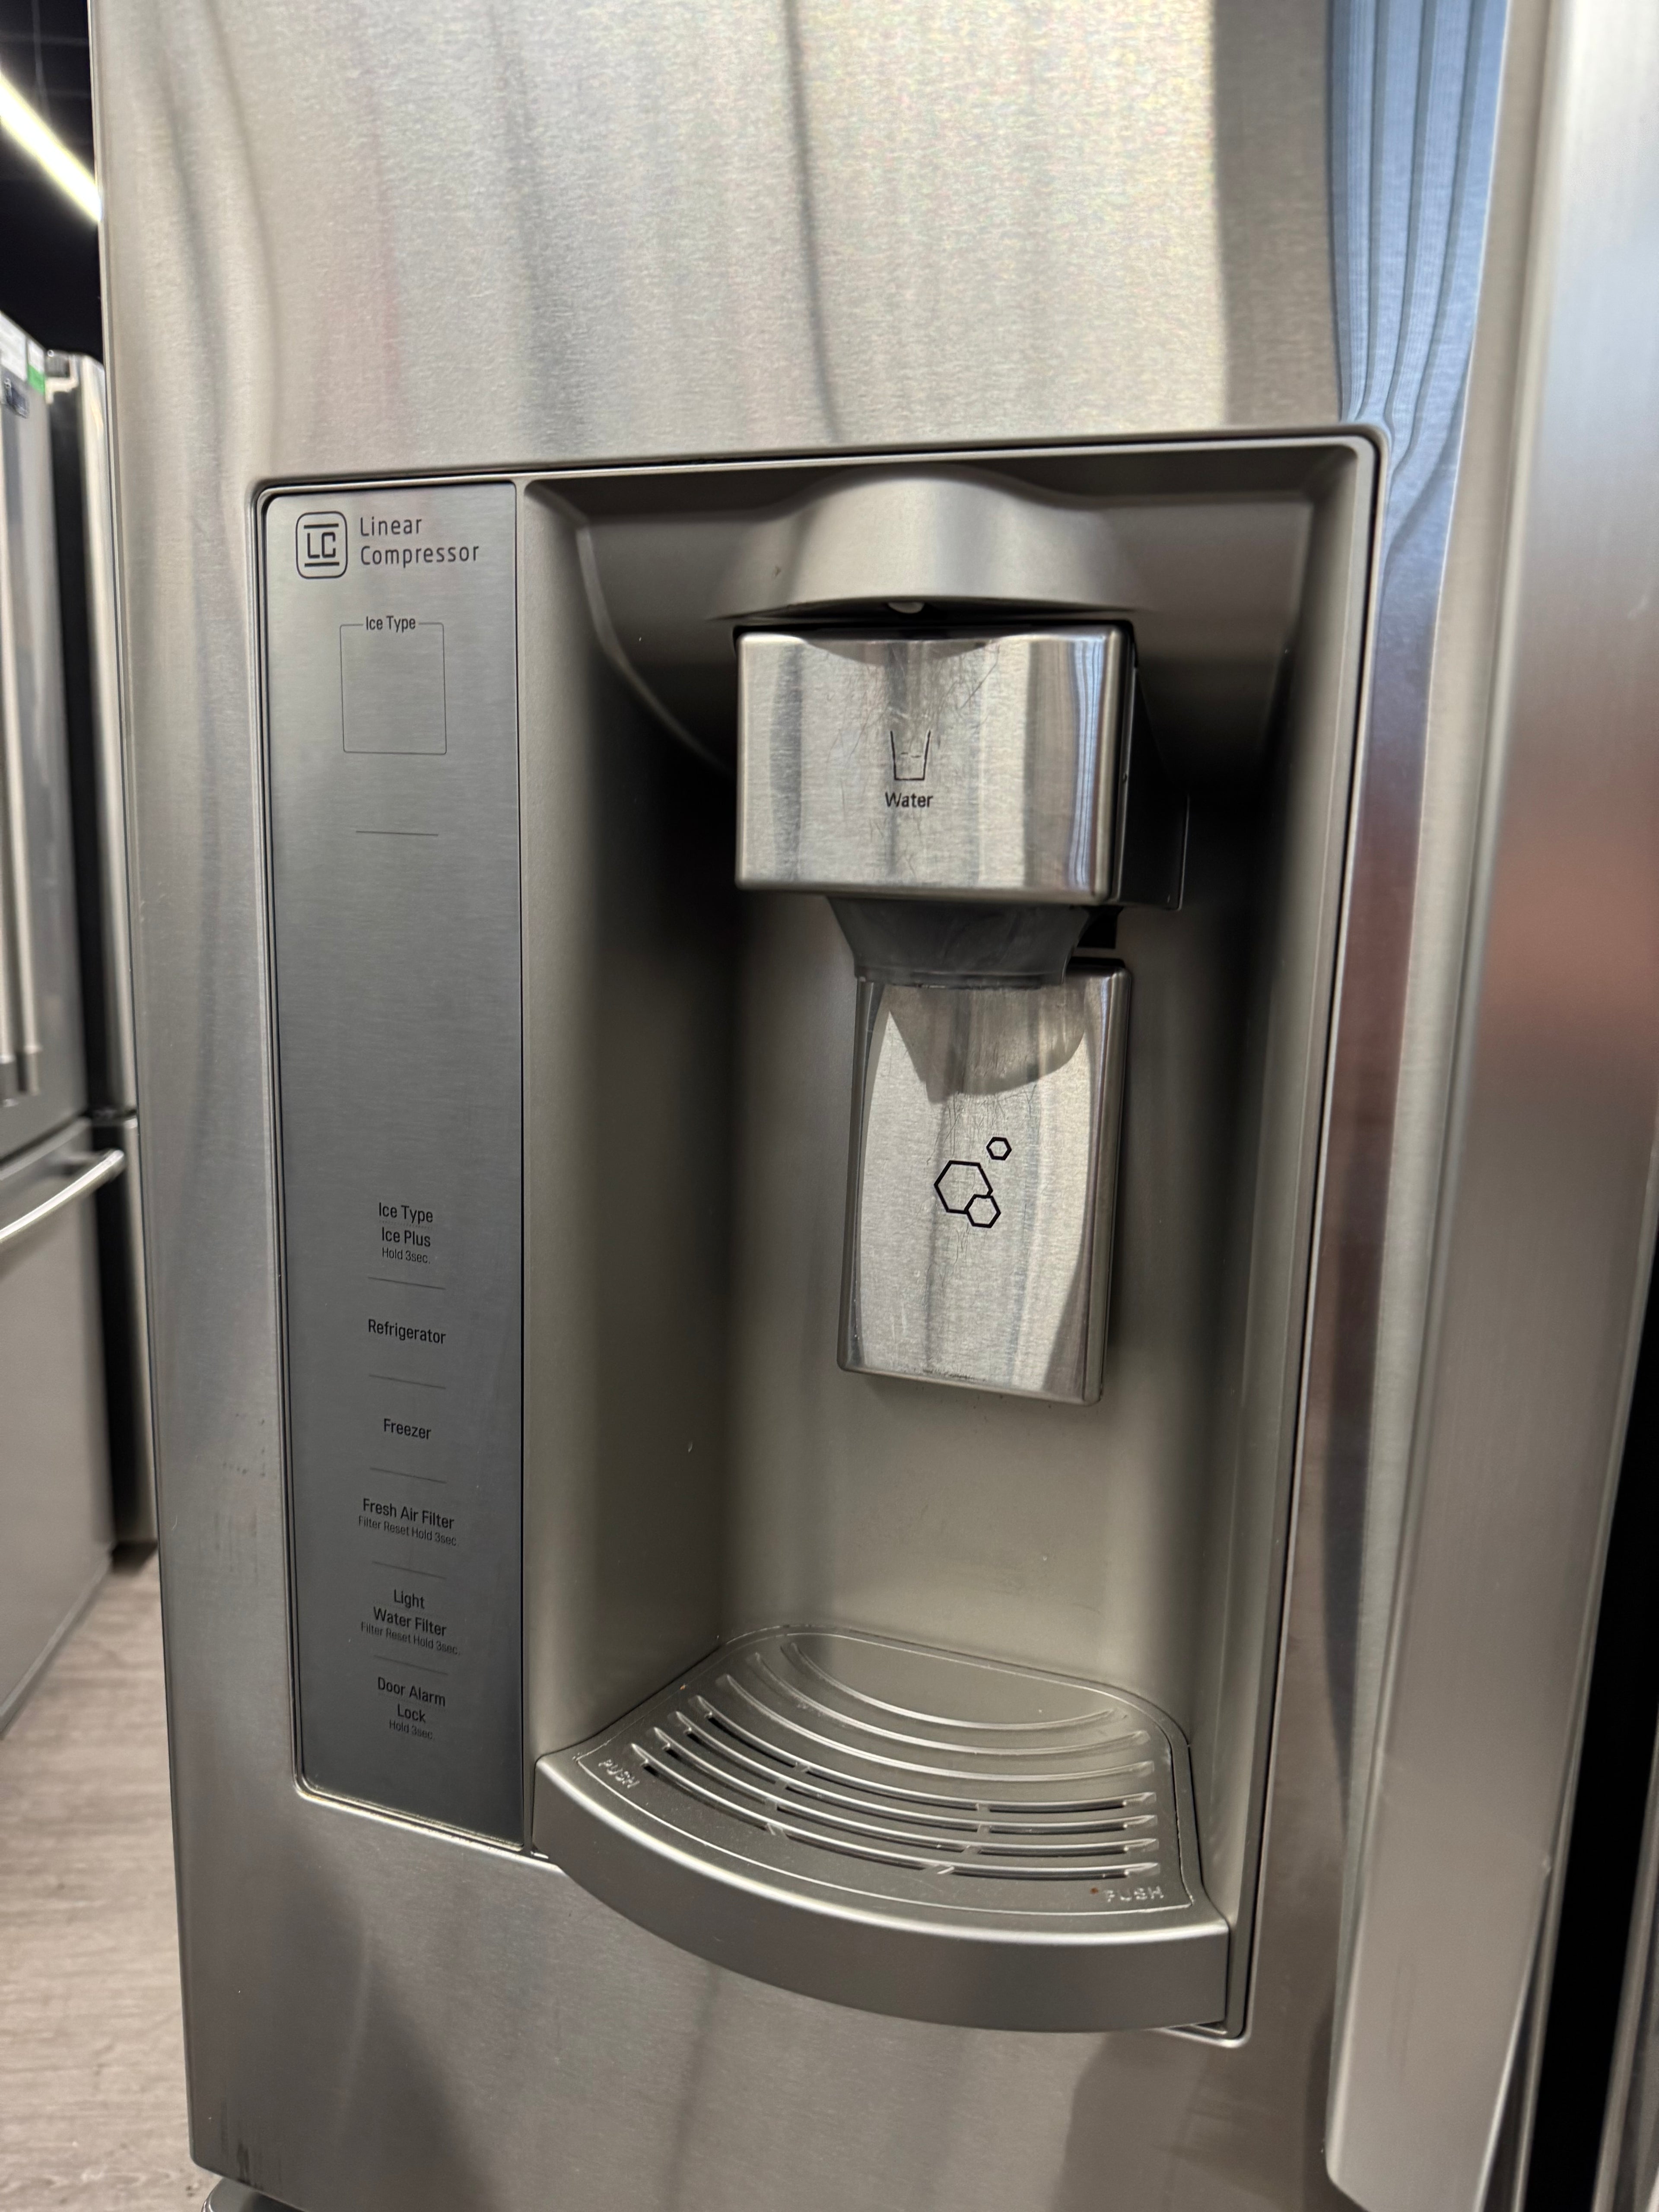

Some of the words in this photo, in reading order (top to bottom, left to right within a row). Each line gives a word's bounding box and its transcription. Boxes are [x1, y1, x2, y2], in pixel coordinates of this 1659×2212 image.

[360, 516, 422, 537] Linear
[307, 531, 336, 559] LC
[361, 544, 480, 568] Compressor
[366, 617, 383, 630] Ice
[386, 615, 416, 633] Type
[885, 791, 933, 808] Water
[378, 1202, 397, 1218] Ice
[401, 1205, 433, 1224] Type
[381, 1227, 400, 1243] Ice
[404, 1230, 431, 1247] Plus
[382, 1247, 403, 1260] Hold
[405, 1250, 431, 1264] 3sec.
[368, 1319, 446, 1344] Refrigerator
[384, 1418, 432, 1440] Freezer
[363, 1498, 397, 1518] Fresh
[400, 1506, 418, 1522] Air
[422, 1510, 454, 1529] Filter
[359, 1516, 381, 1530] Filter
[384, 1521, 410, 1536] Reset
[412, 1528, 432, 1541] Hold
[394, 1589, 425, 1609] Light
[373, 1606, 412, 1628] Water
[415, 1617, 447, 1637] Filter
[361, 1621, 384, 1636] Filter
[386, 1628, 411, 1644] Reset
[413, 1634, 434, 1649] Hold
[378, 1677, 406, 1696] Door
[409, 1685, 446, 1707] Alarm
[397, 1703, 426, 1723] Lock
[389, 1720, 410, 1734] Hold
